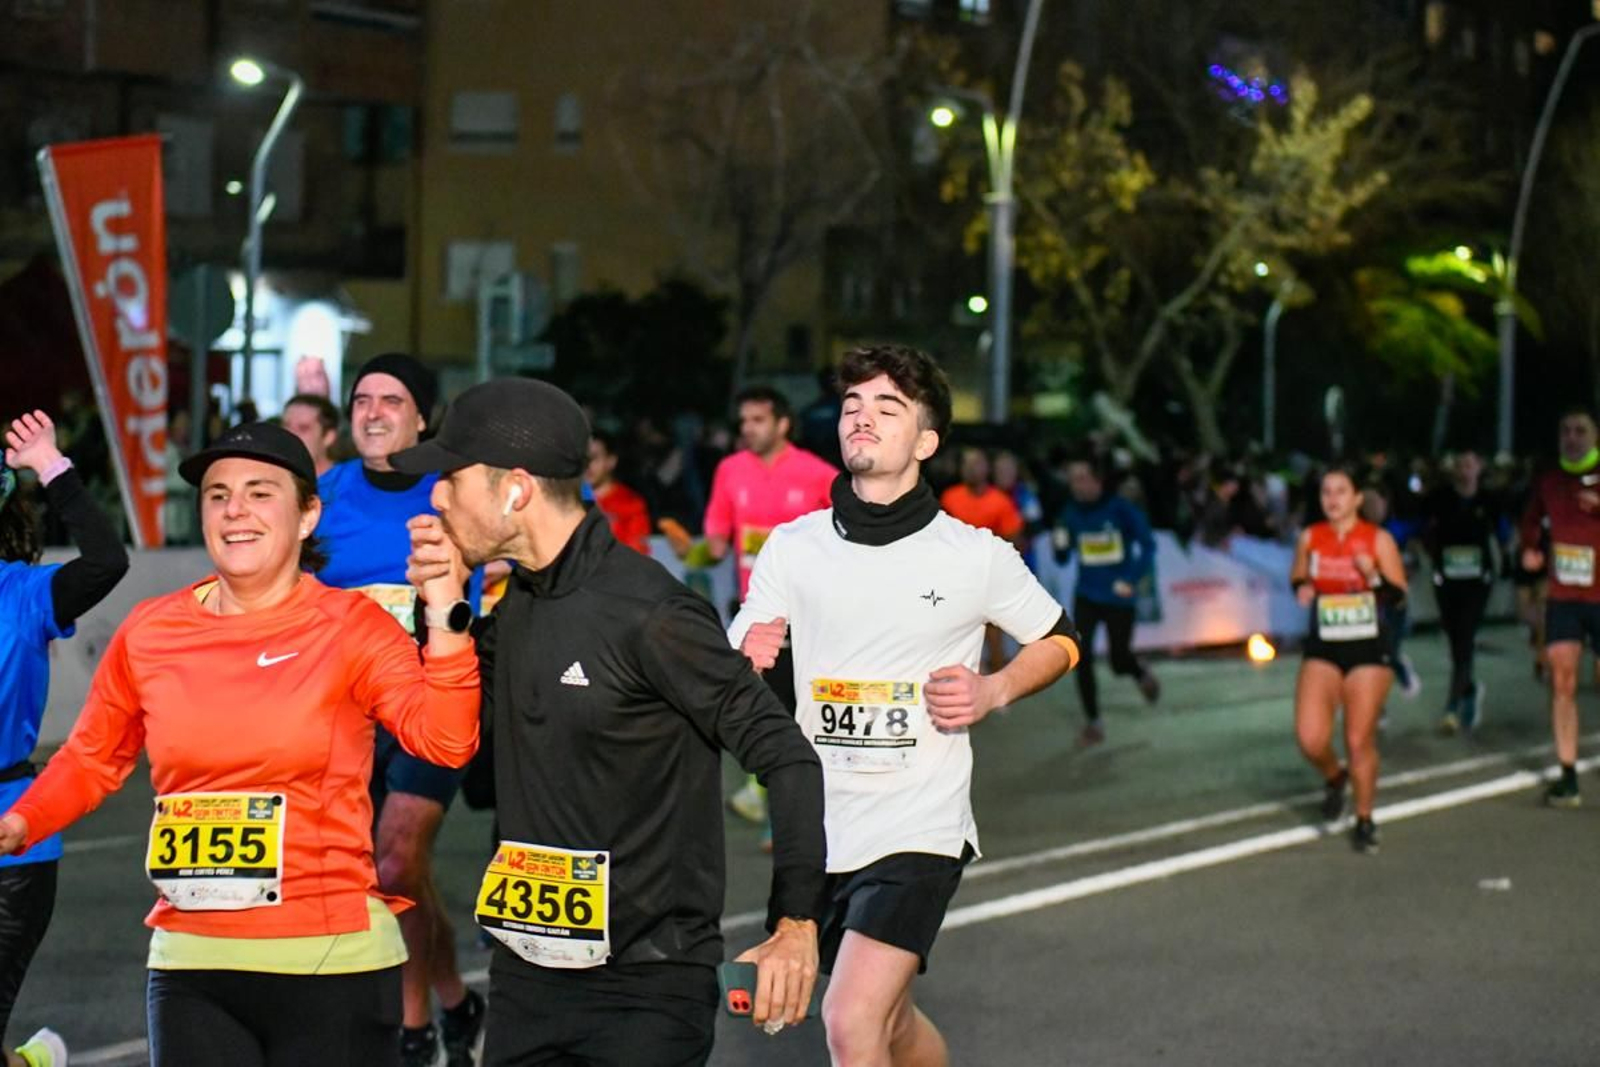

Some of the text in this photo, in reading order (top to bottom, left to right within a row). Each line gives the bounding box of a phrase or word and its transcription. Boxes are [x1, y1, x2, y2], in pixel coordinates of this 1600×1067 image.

[821, 704, 909, 737] 9478
[172, 800, 193, 818] 42
[158, 827, 267, 865] 3155
[508, 850, 526, 870] 42
[485, 877, 593, 926] 4356
